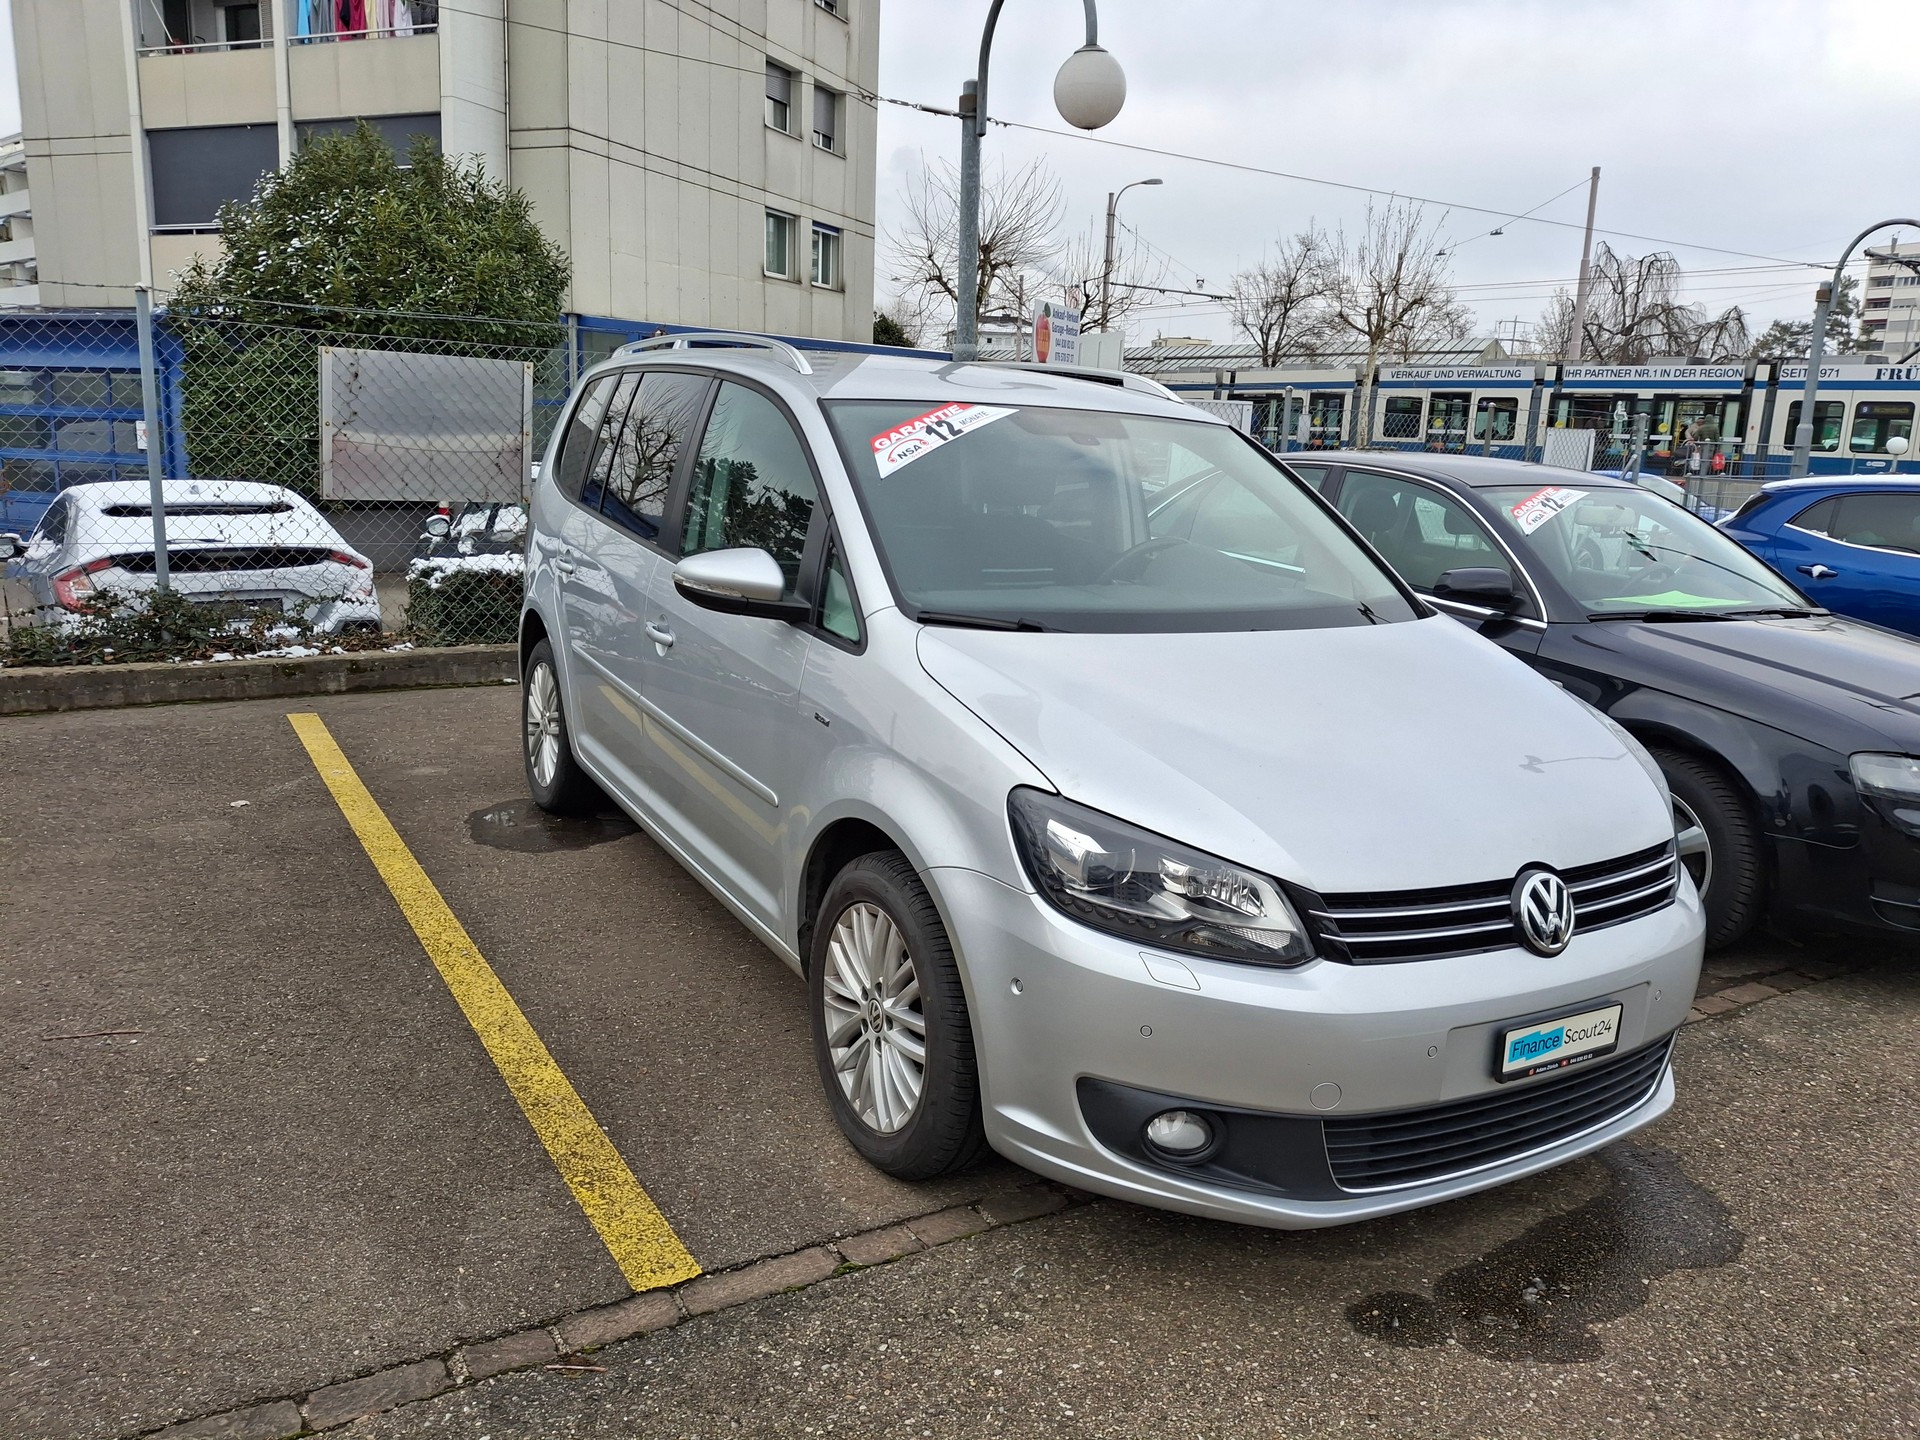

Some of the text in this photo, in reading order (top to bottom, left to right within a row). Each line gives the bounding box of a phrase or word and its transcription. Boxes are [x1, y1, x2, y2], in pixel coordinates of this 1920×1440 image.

[1391, 369, 1521, 379] VERKAUF UND VERWALTUNG
[1565, 369, 1582, 377] IHR
[1584, 369, 1631, 377] PARTNER
[1659, 369, 1671, 377] IN
[1674, 369, 1697, 377] DER
[1699, 368, 1744, 378] REGION
[1781, 368, 1840, 378] SEIT 971
[874, 404, 964, 450] GARANTIE
[925, 410, 989, 442] 12 MONATE
[896, 444, 923, 460] NSA
[1513, 487, 1558, 517] GARANTIE
[1540, 497, 1565, 512] 12
[1531, 513, 1545, 524] NSA
[1511, 1018, 1612, 1058] Finance Scout24
